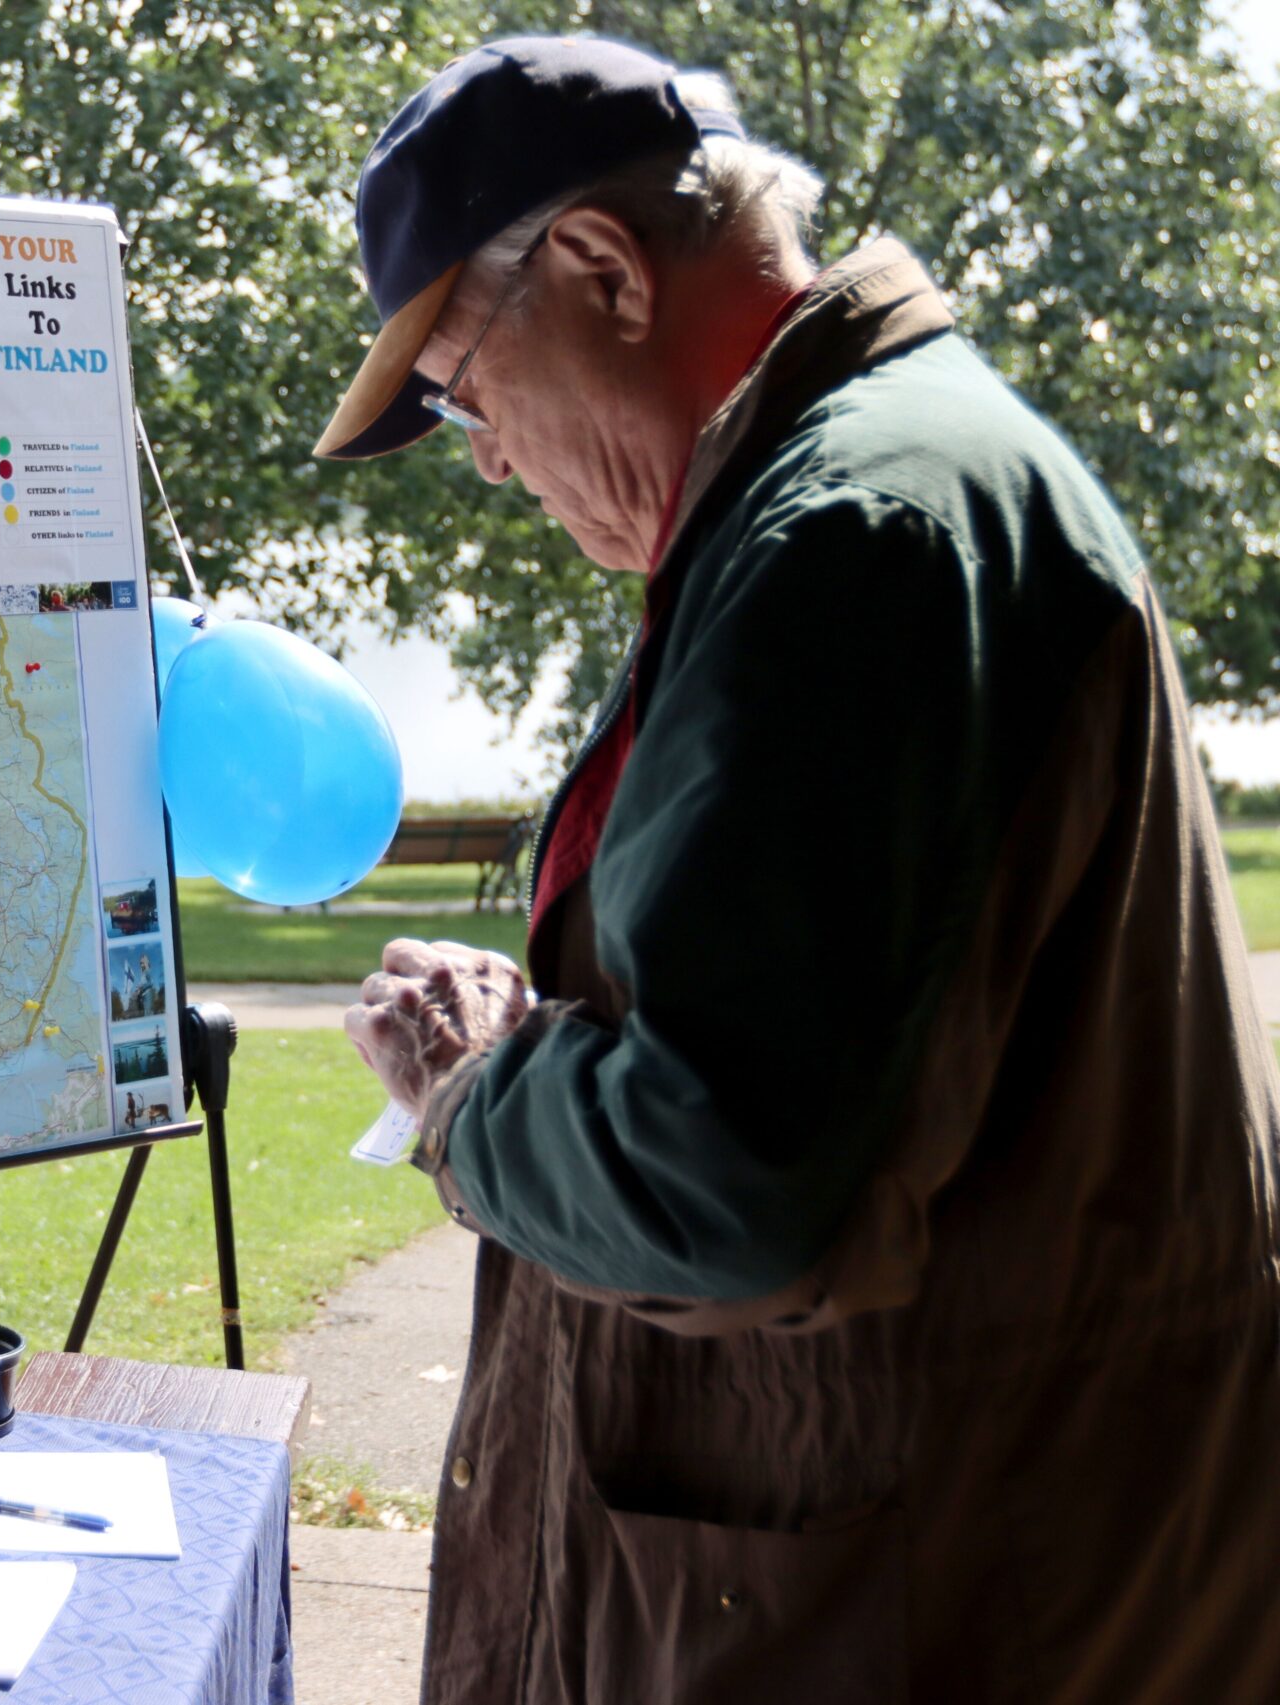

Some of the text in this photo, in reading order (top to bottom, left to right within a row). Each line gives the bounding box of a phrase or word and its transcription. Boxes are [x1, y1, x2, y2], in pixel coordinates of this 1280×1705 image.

[4, 272, 77, 300] Links
[28, 310, 61, 335] To
[22, 443, 61, 451] TRAVELED
[70, 442, 100, 451] Finland
[24, 465, 65, 473] RELATIVES
[73, 464, 103, 472] Finland
[26, 486, 96, 495] CITIZEN of Finland
[29, 509, 62, 517] FRIENDS
[71, 508, 101, 516] Finland
[31, 530, 115, 540] OTHER links to Finland
